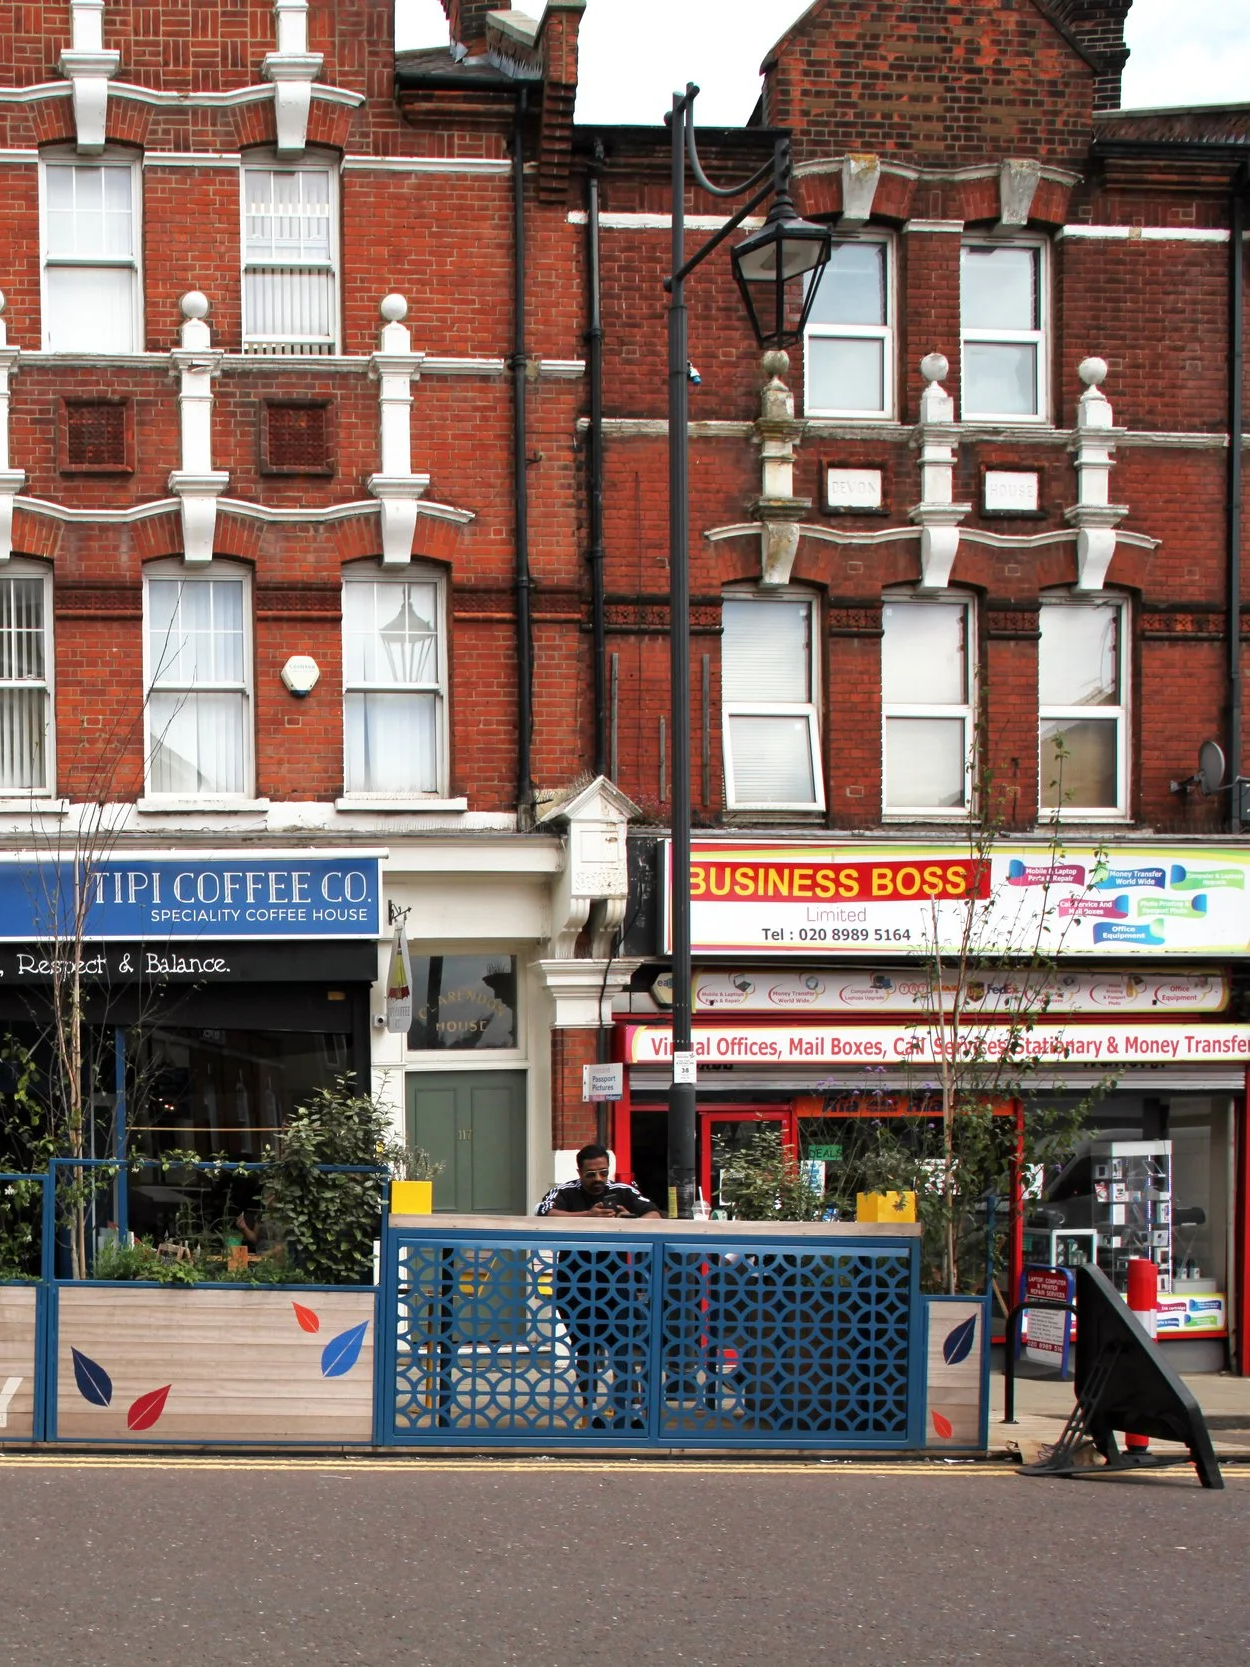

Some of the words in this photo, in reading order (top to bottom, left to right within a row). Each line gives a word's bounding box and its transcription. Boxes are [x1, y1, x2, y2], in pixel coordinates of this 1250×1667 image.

[831, 480, 877, 494] DEVON
[990, 484, 1033, 498] HOUSE
[1055, 868, 1077, 876] Laptop
[1134, 870, 1162, 878] Transfer
[91, 871, 161, 904] TIPI
[173, 871, 311, 904] COFFEE
[321, 871, 372, 903] CO.
[690, 867, 860, 898] BUSINESS
[872, 866, 967, 895] BOSS
[151, 909, 241, 922] SPECIALITY
[246, 908, 307, 921] COFFEE
[313, 908, 367, 921] HOUSE
[806, 907, 866, 922] Limited
[762, 928, 784, 941] Tel
[799, 929, 827, 941] 020
[832, 929, 869, 941] 8989
[875, 928, 911, 941] 5164
[1102, 932, 1146, 940] Equipment
[119, 953, 133, 973] &
[146, 952, 231, 973] Balance.
[1170, 984, 1189, 992] Office
[1162, 993, 1197, 1002] Equipment
[436, 1020, 487, 1032] HOUSE
[651, 1036, 711, 1056] Vial
[716, 1036, 782, 1060] Offices,
[789, 1036, 825, 1055] Mail
[832, 1036, 887, 1060] Boxes,
[1107, 1036, 1119, 1054] &
[1125, 1035, 1179, 1058] Money
[592, 1075, 616, 1083] Passport
